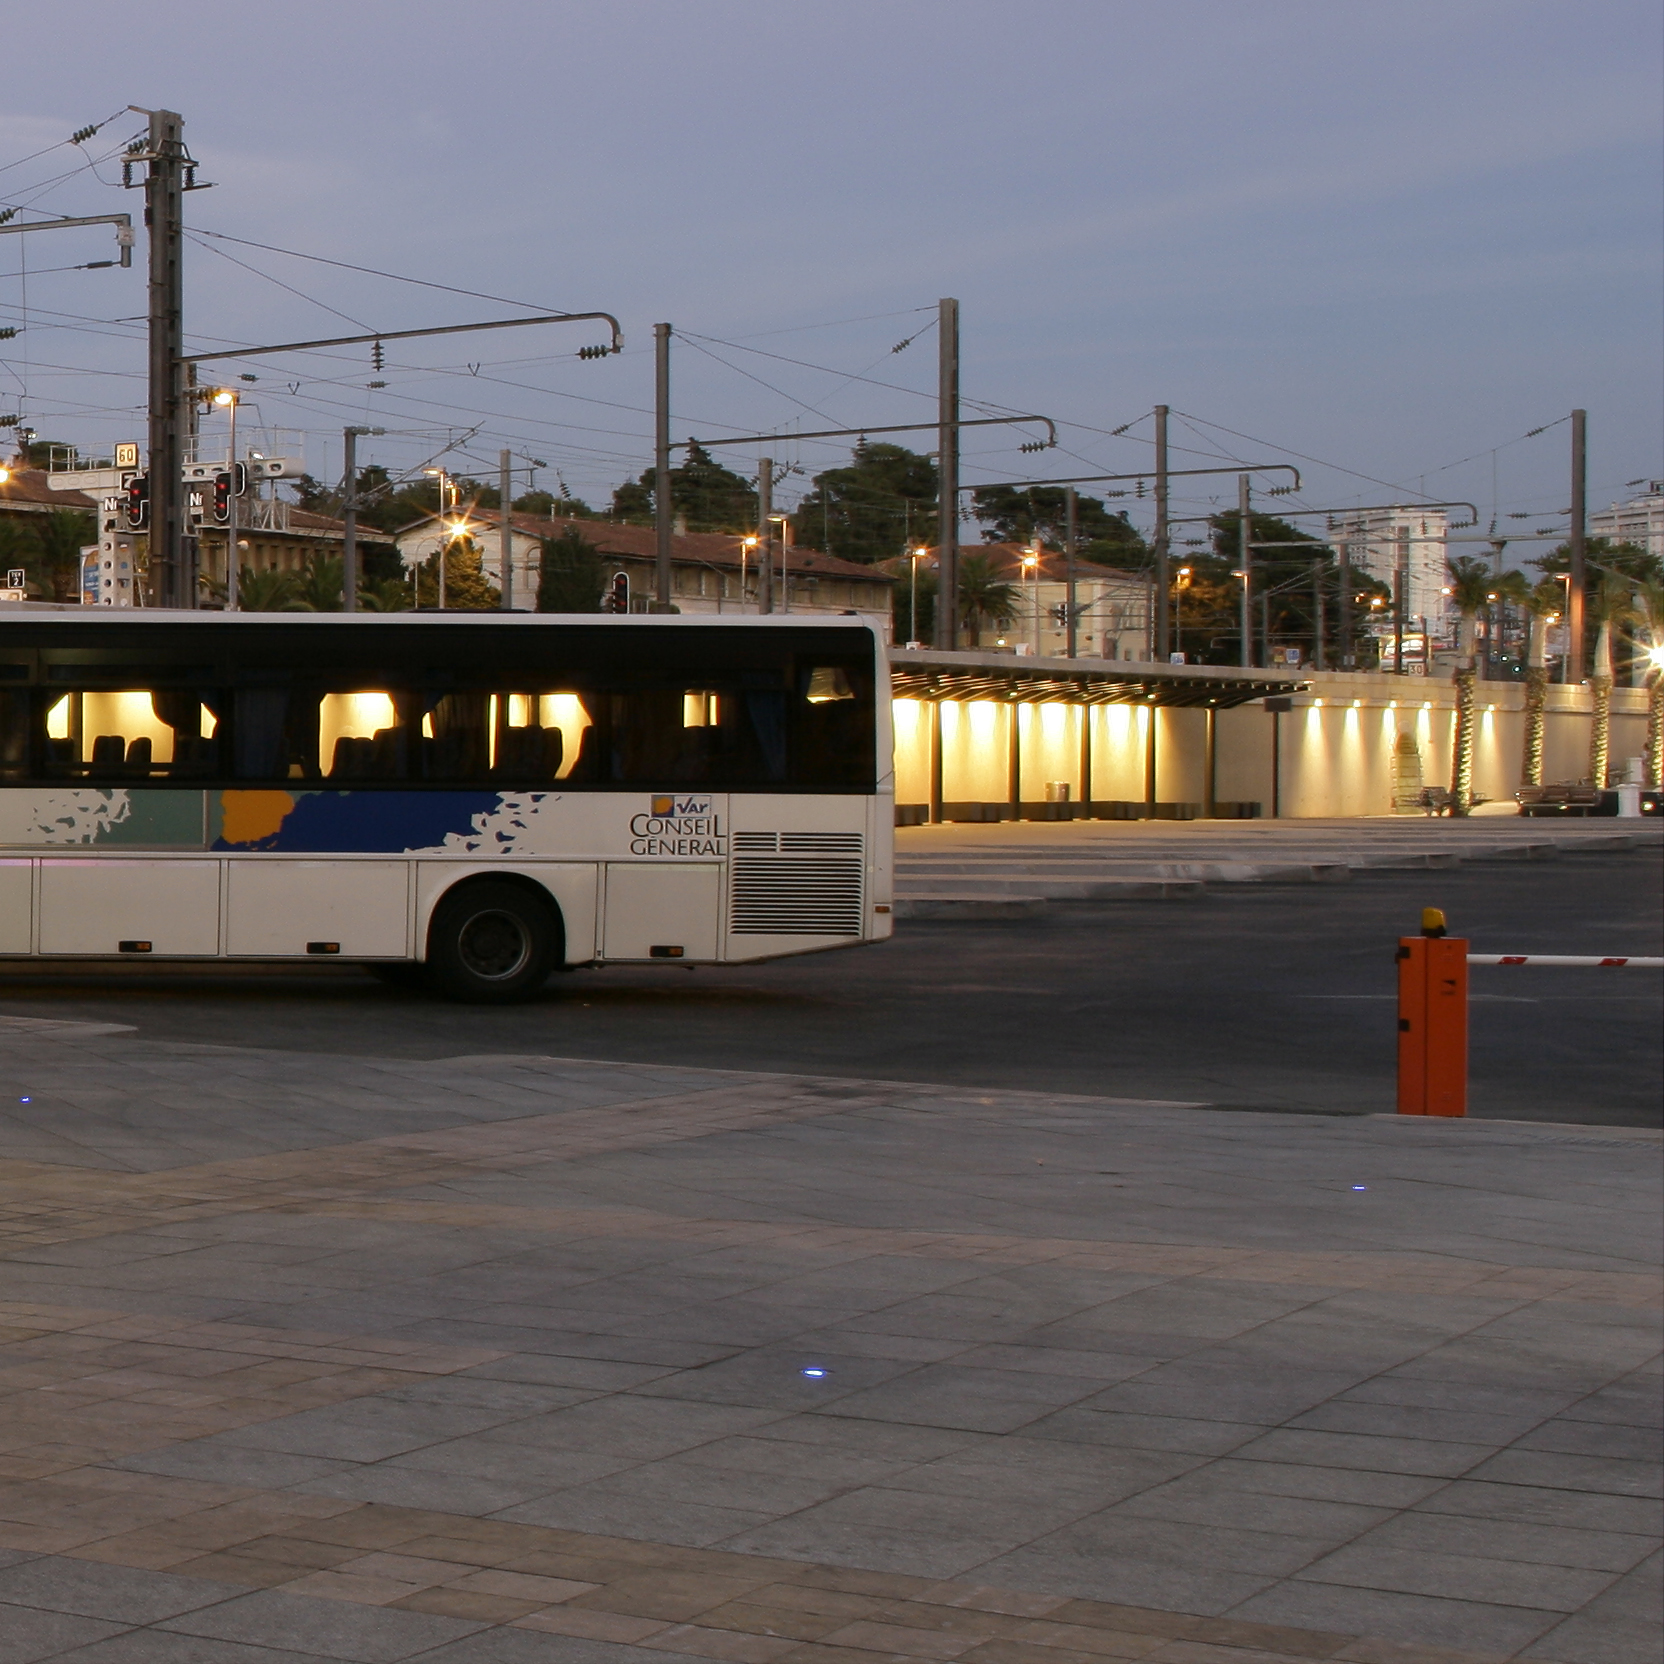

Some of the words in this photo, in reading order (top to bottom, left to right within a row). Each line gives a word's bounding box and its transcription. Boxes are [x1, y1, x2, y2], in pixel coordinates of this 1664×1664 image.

[118, 449, 134, 462] 60
[1410, 665, 1422, 674] 30
[629, 813, 727, 838] CONSEIL
